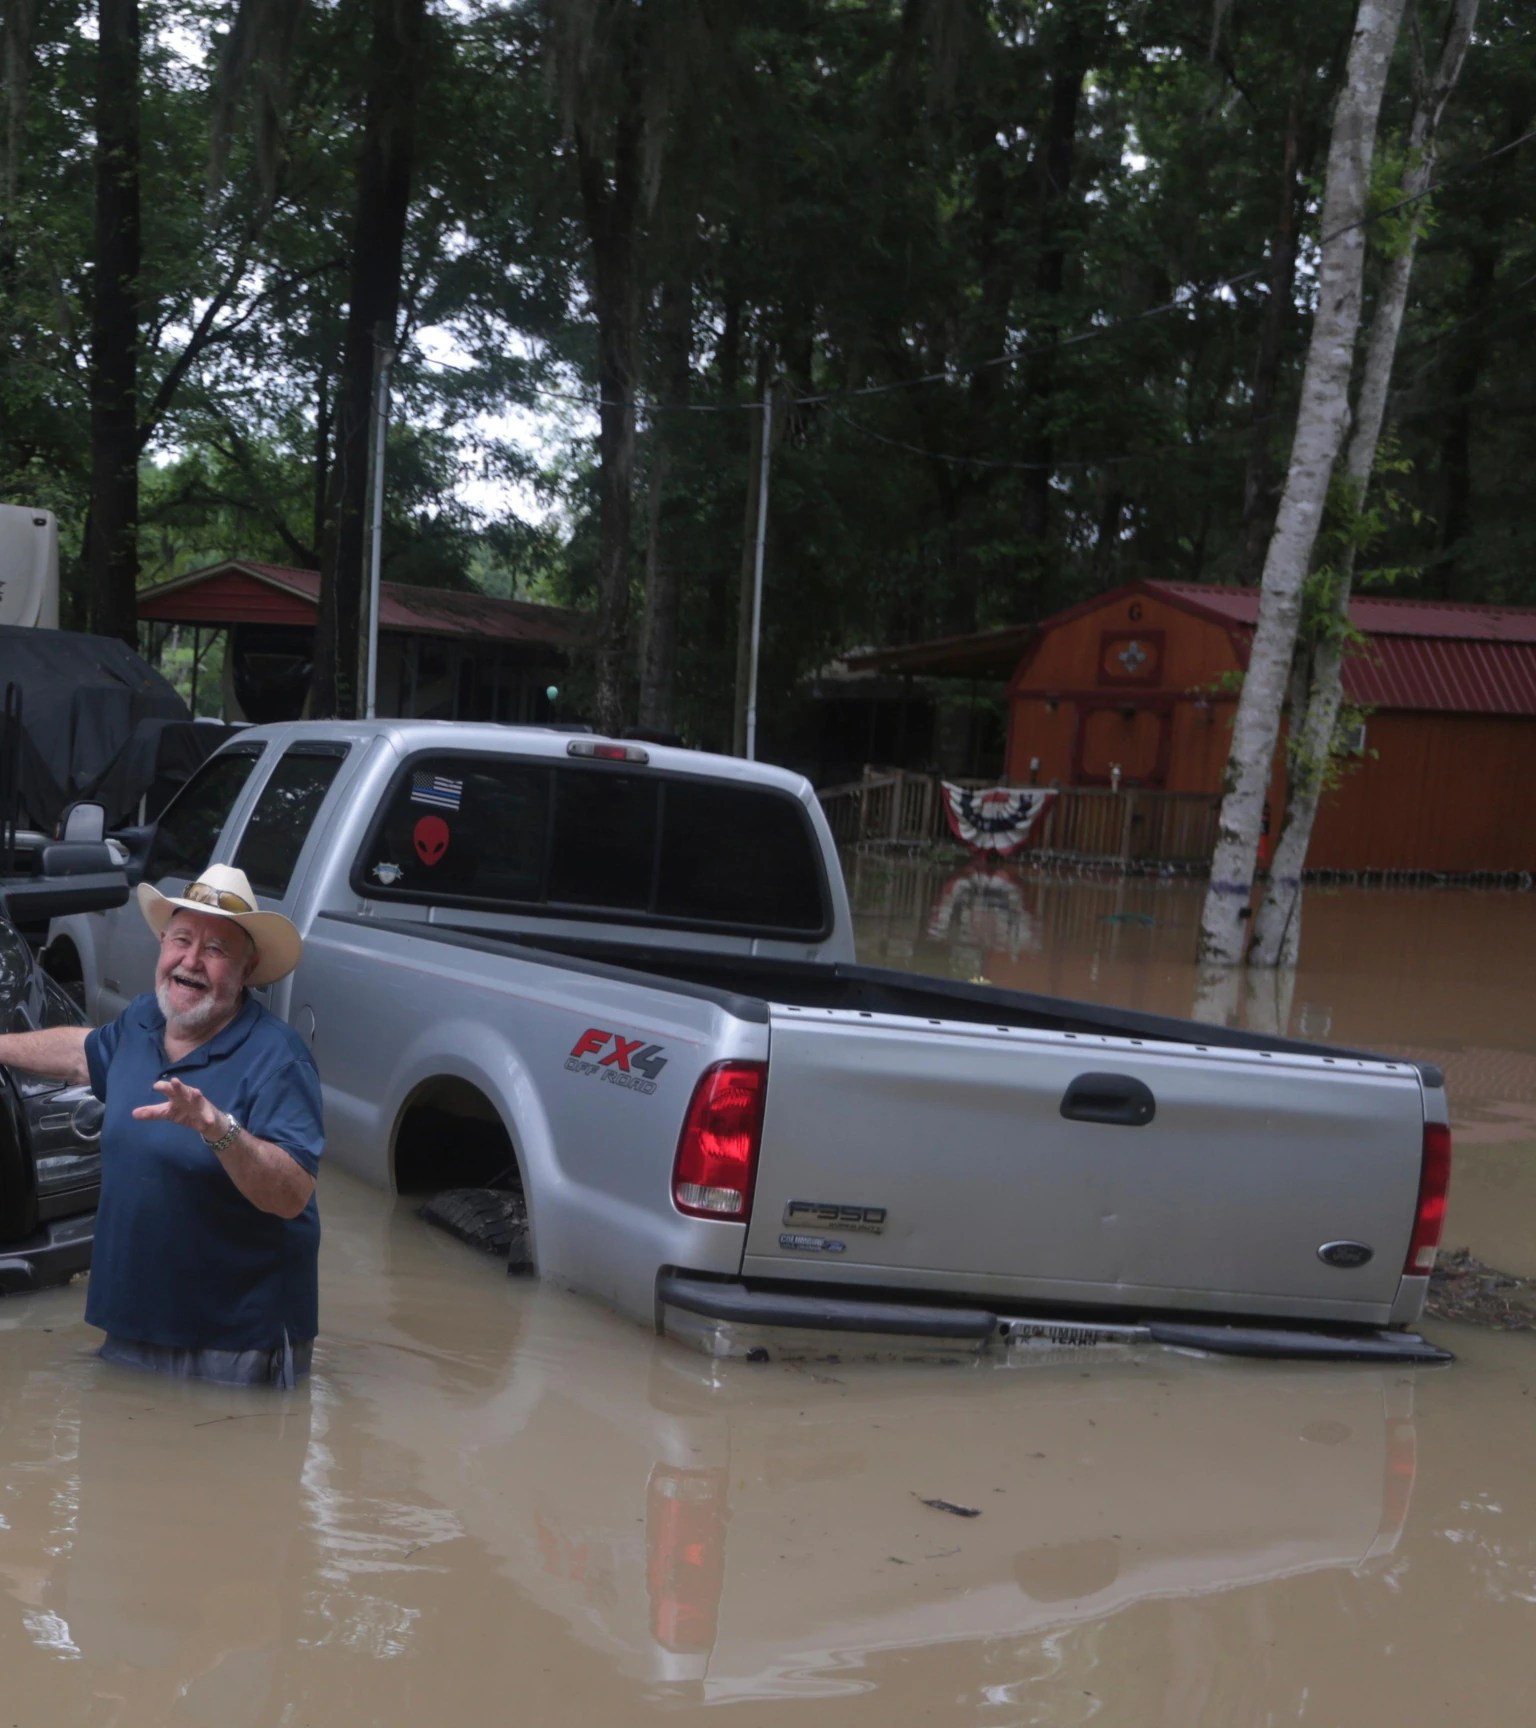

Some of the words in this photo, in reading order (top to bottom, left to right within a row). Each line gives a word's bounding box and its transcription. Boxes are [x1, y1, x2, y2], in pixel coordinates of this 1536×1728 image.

[564, 1057, 601, 1076] OFF
[600, 1068, 658, 1096] ROAD
[570, 1028, 668, 1080] FX4
